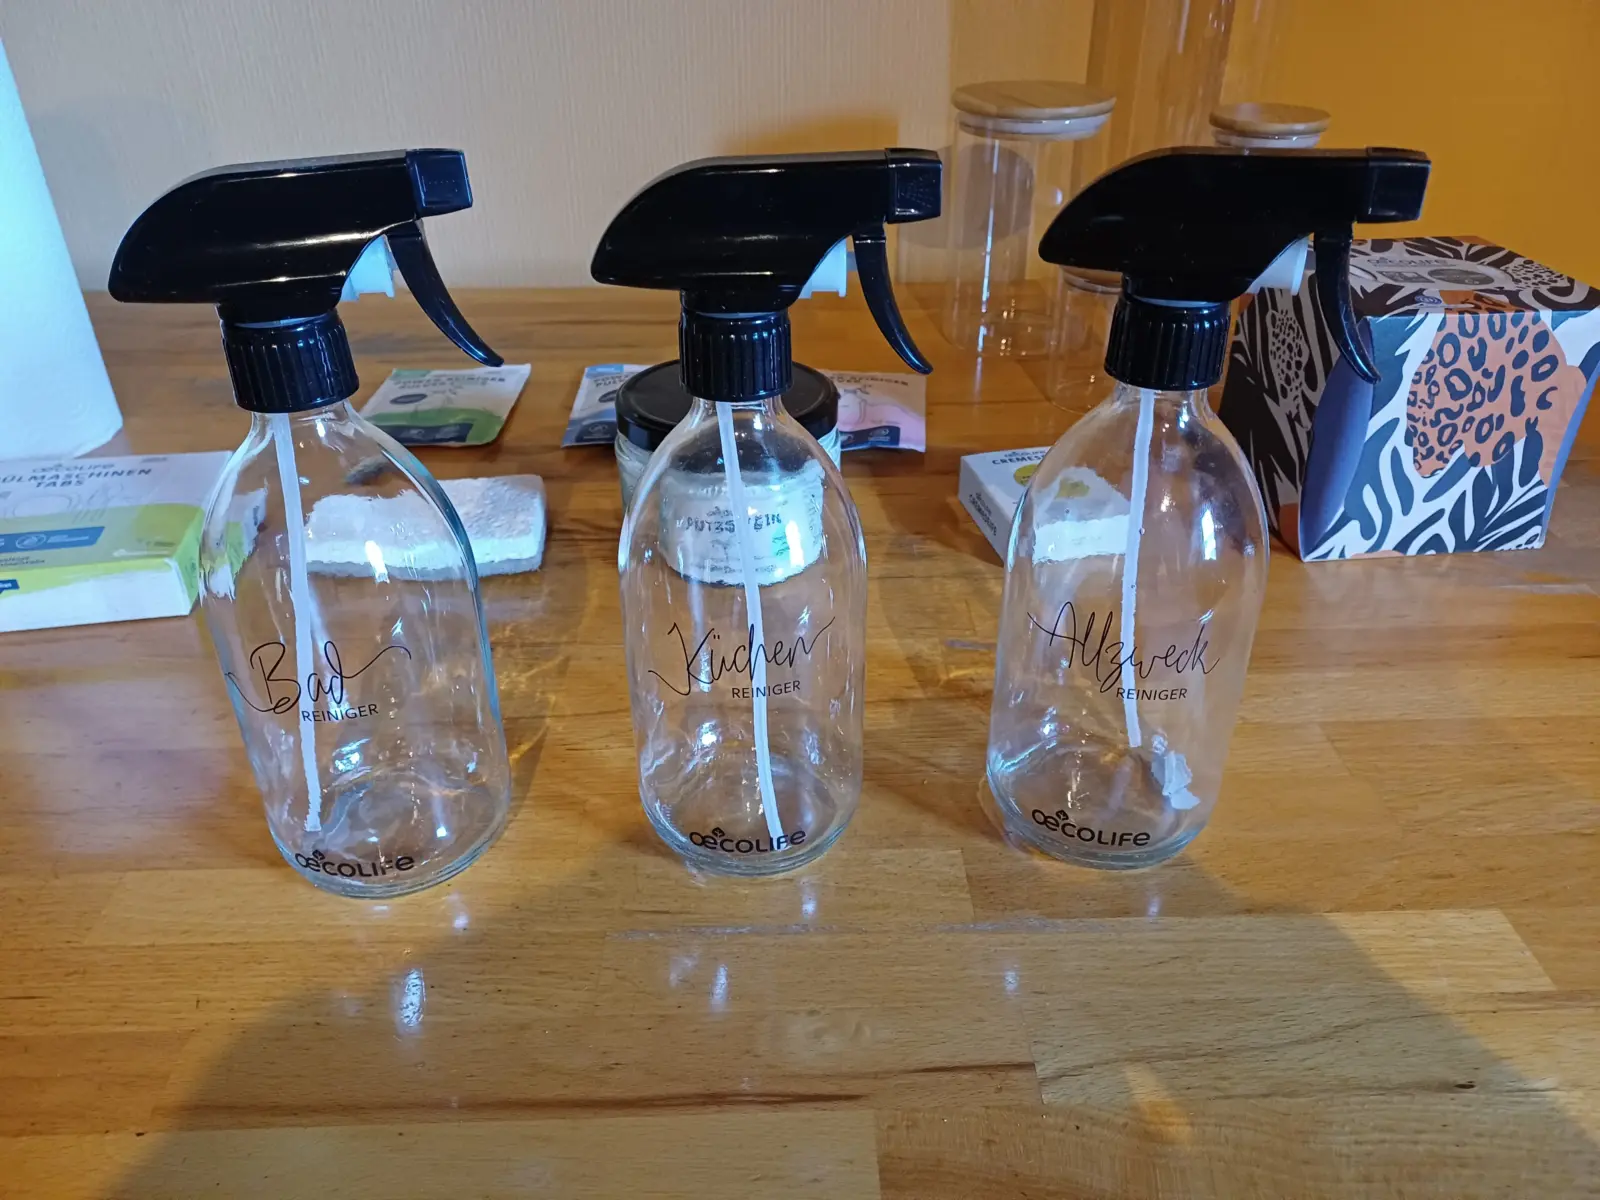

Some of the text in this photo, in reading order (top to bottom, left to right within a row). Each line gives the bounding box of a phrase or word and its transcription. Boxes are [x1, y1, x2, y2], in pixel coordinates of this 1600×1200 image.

[992, 454, 1046, 465] CREMES
[0, 468, 152, 484] ÜLMASCHINEN
[36, 479, 85, 488] TABS
[686, 512, 783, 534] PUTZSEIN
[648, 616, 836, 696] Küchen
[1027, 601, 1221, 693] Allzweck
[224, 640, 412, 714] Bad
[732, 680, 801, 699] REINIGER
[1116, 687, 1188, 701] REINIGER
[301, 703, 379, 722] REINIGER
